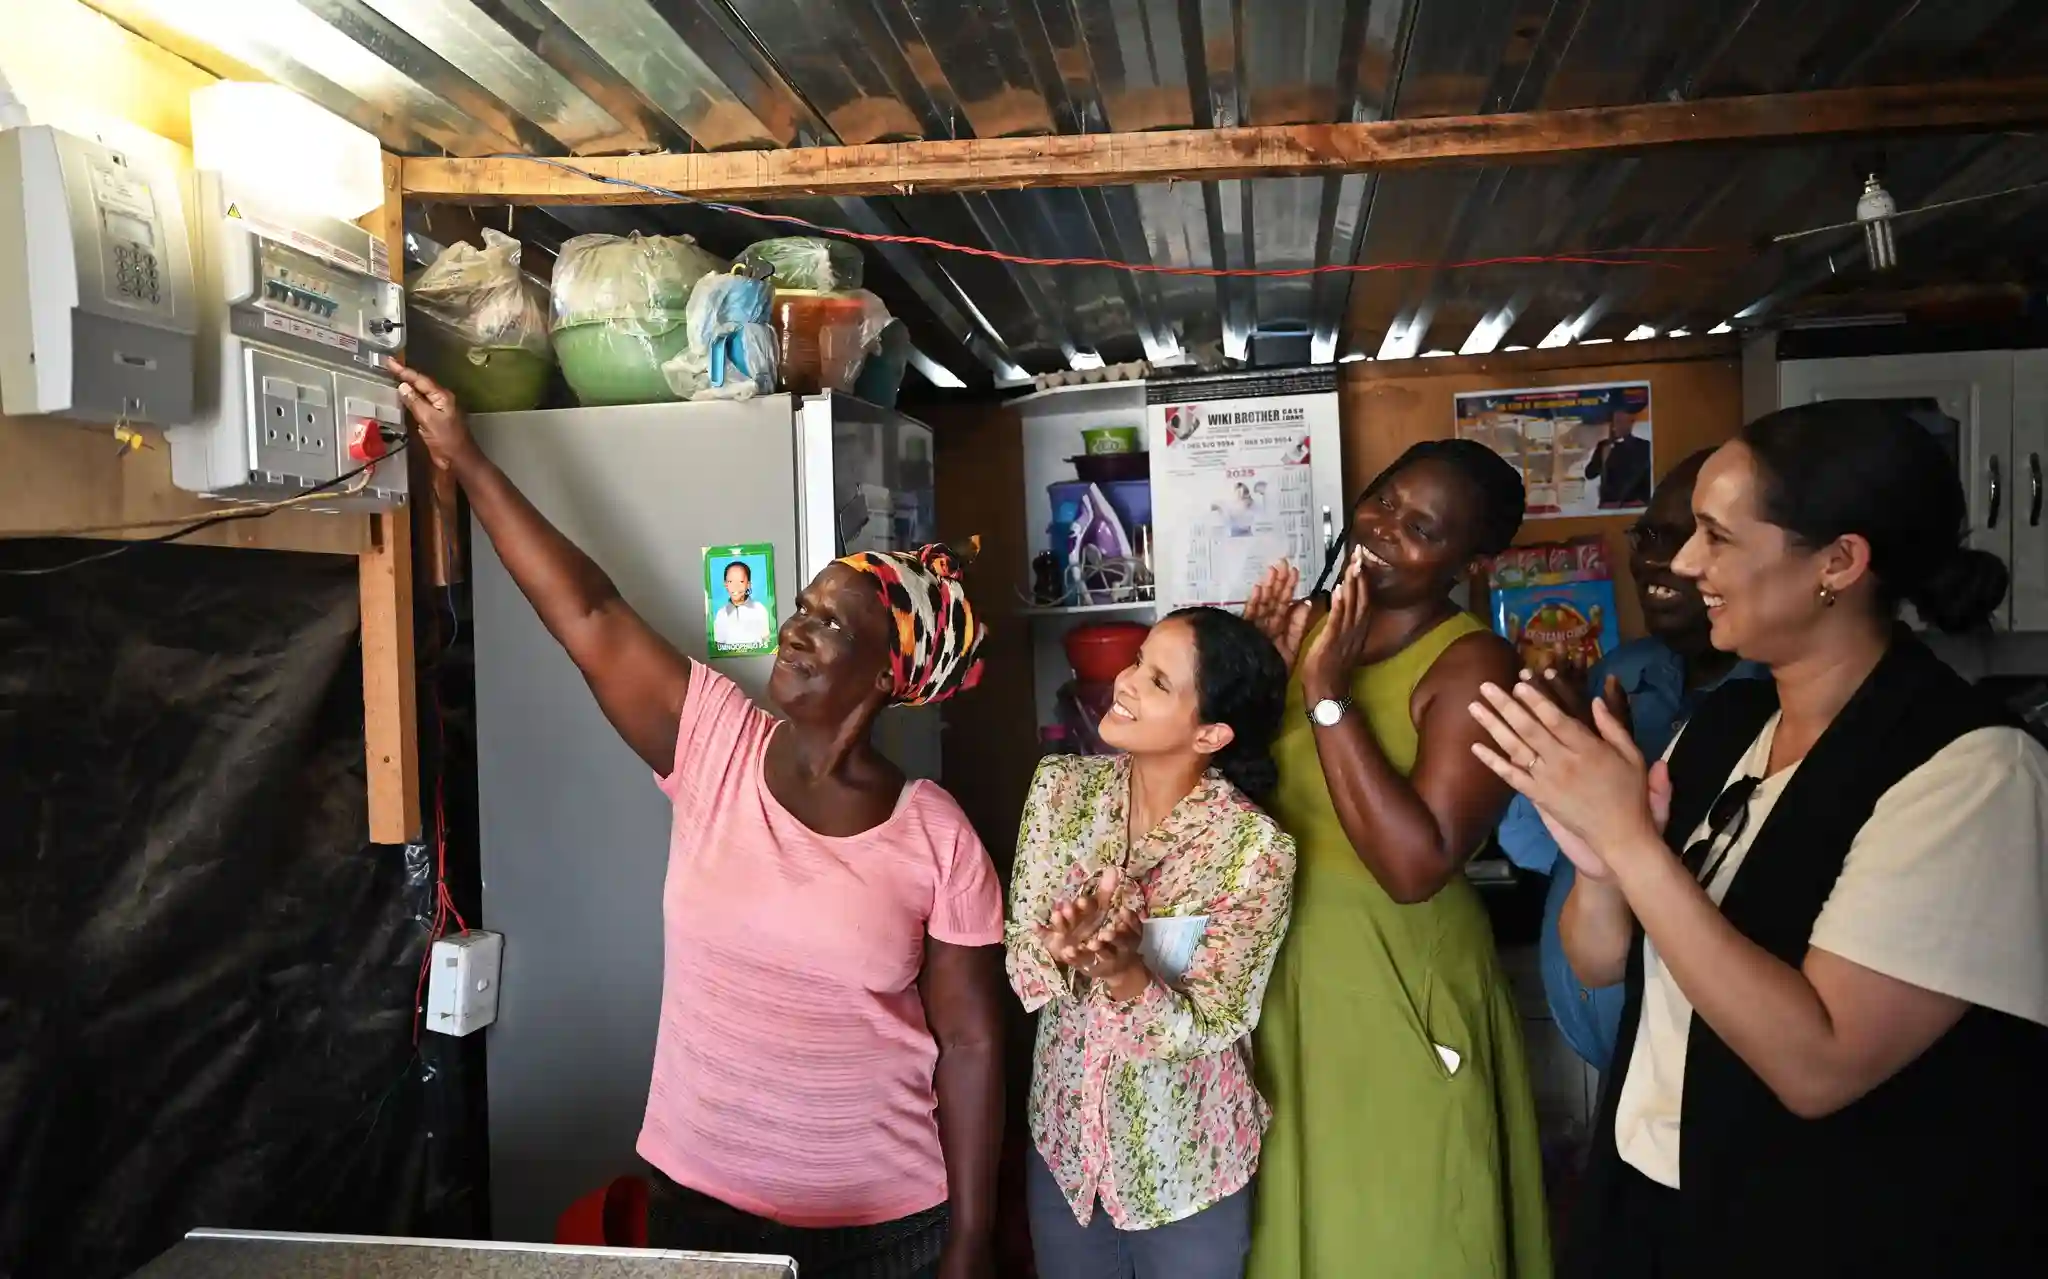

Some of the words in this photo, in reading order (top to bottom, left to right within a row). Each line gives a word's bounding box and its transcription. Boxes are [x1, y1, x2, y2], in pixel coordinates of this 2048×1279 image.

[1208, 413, 1232, 425] WIKI
[1234, 409, 1280, 425] BROTHER
[1226, 469, 1256, 479] 2025
